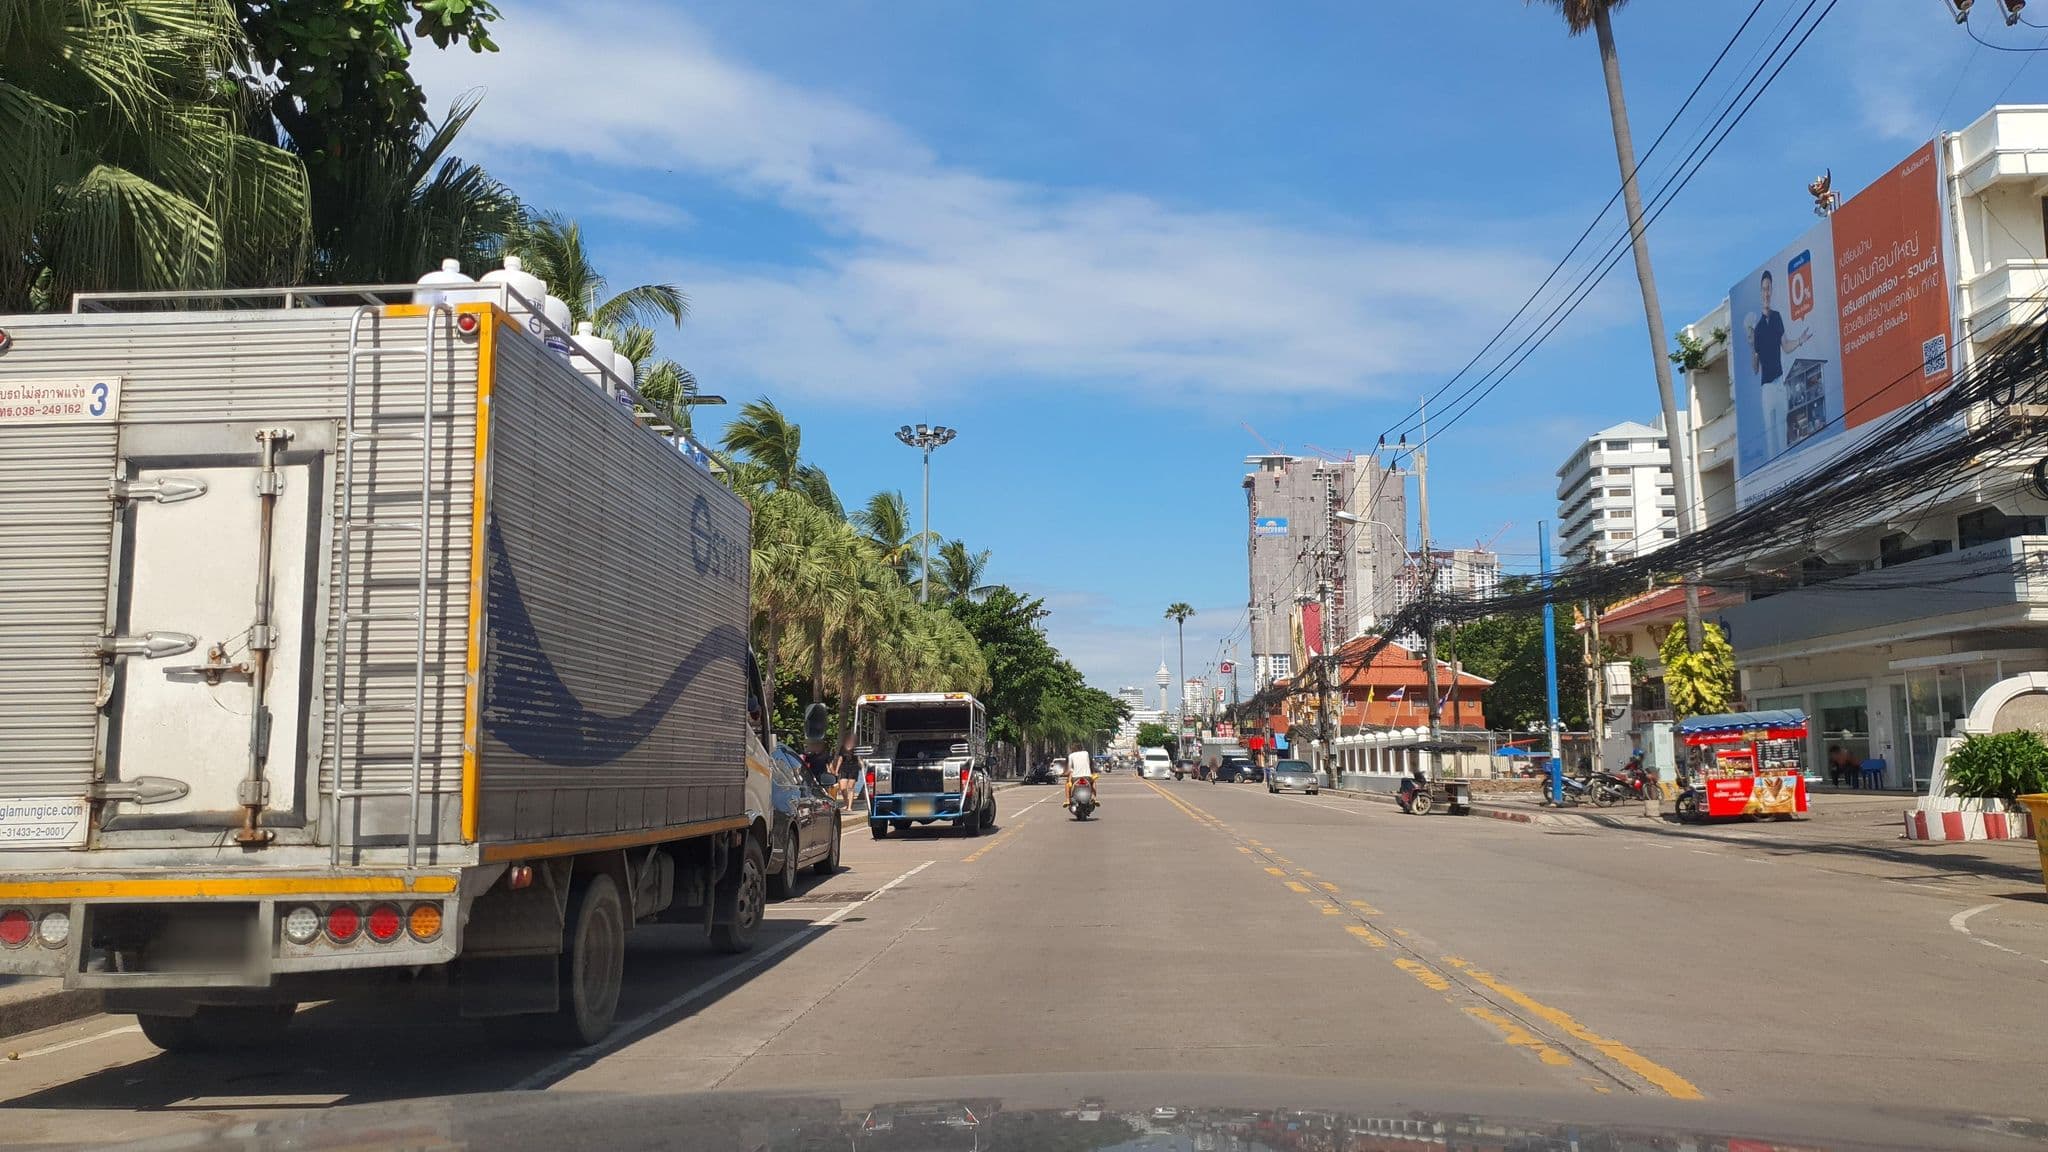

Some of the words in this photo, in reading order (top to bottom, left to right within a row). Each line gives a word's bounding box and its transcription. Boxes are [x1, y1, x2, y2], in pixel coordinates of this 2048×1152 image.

[1840, 230, 1919, 296] เป็นเงินก้อนใหญ่
[64, 404, 81, 415] 162
[89, 382, 109, 417] 3
